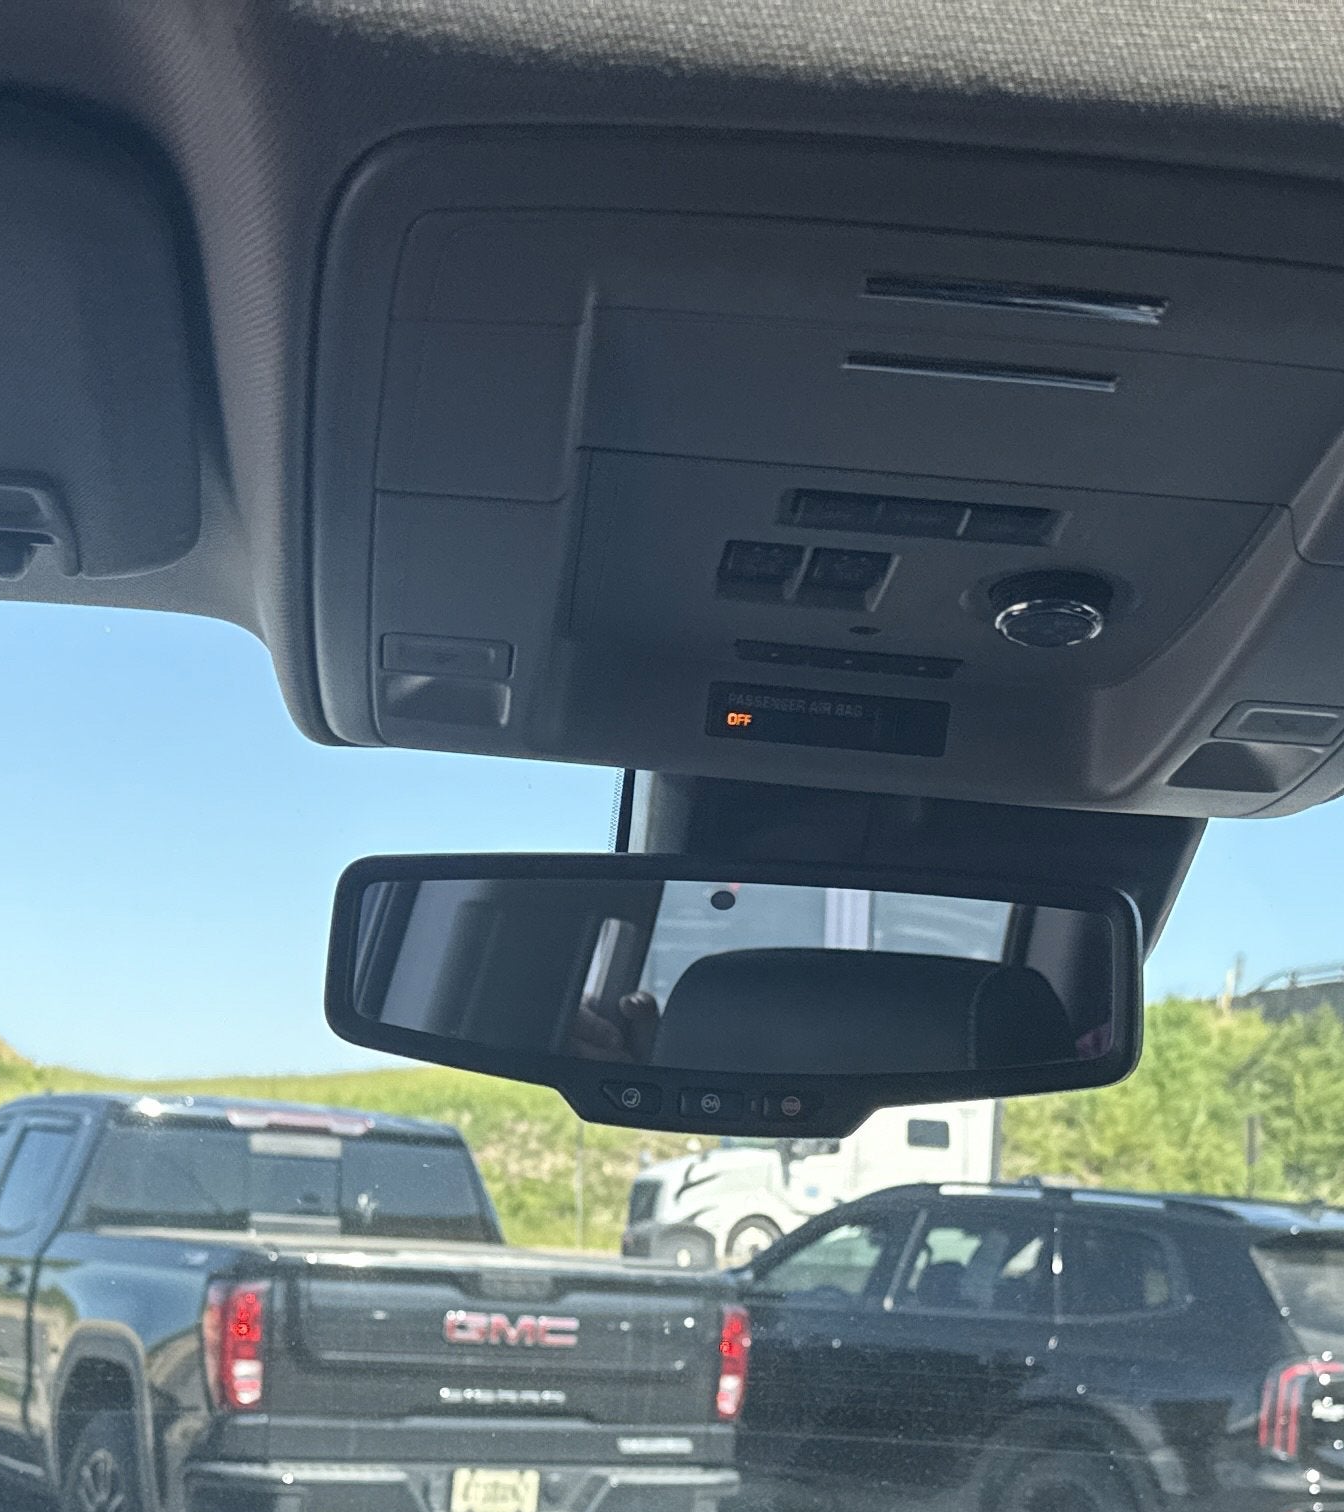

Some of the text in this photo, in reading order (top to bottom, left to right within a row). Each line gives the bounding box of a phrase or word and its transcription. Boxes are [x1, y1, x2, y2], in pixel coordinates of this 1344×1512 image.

[808, 702, 832, 717] AIR
[835, 703, 864, 718] BAG
[727, 712, 752, 726] OFF
[444, 1310, 580, 1346] GMC
